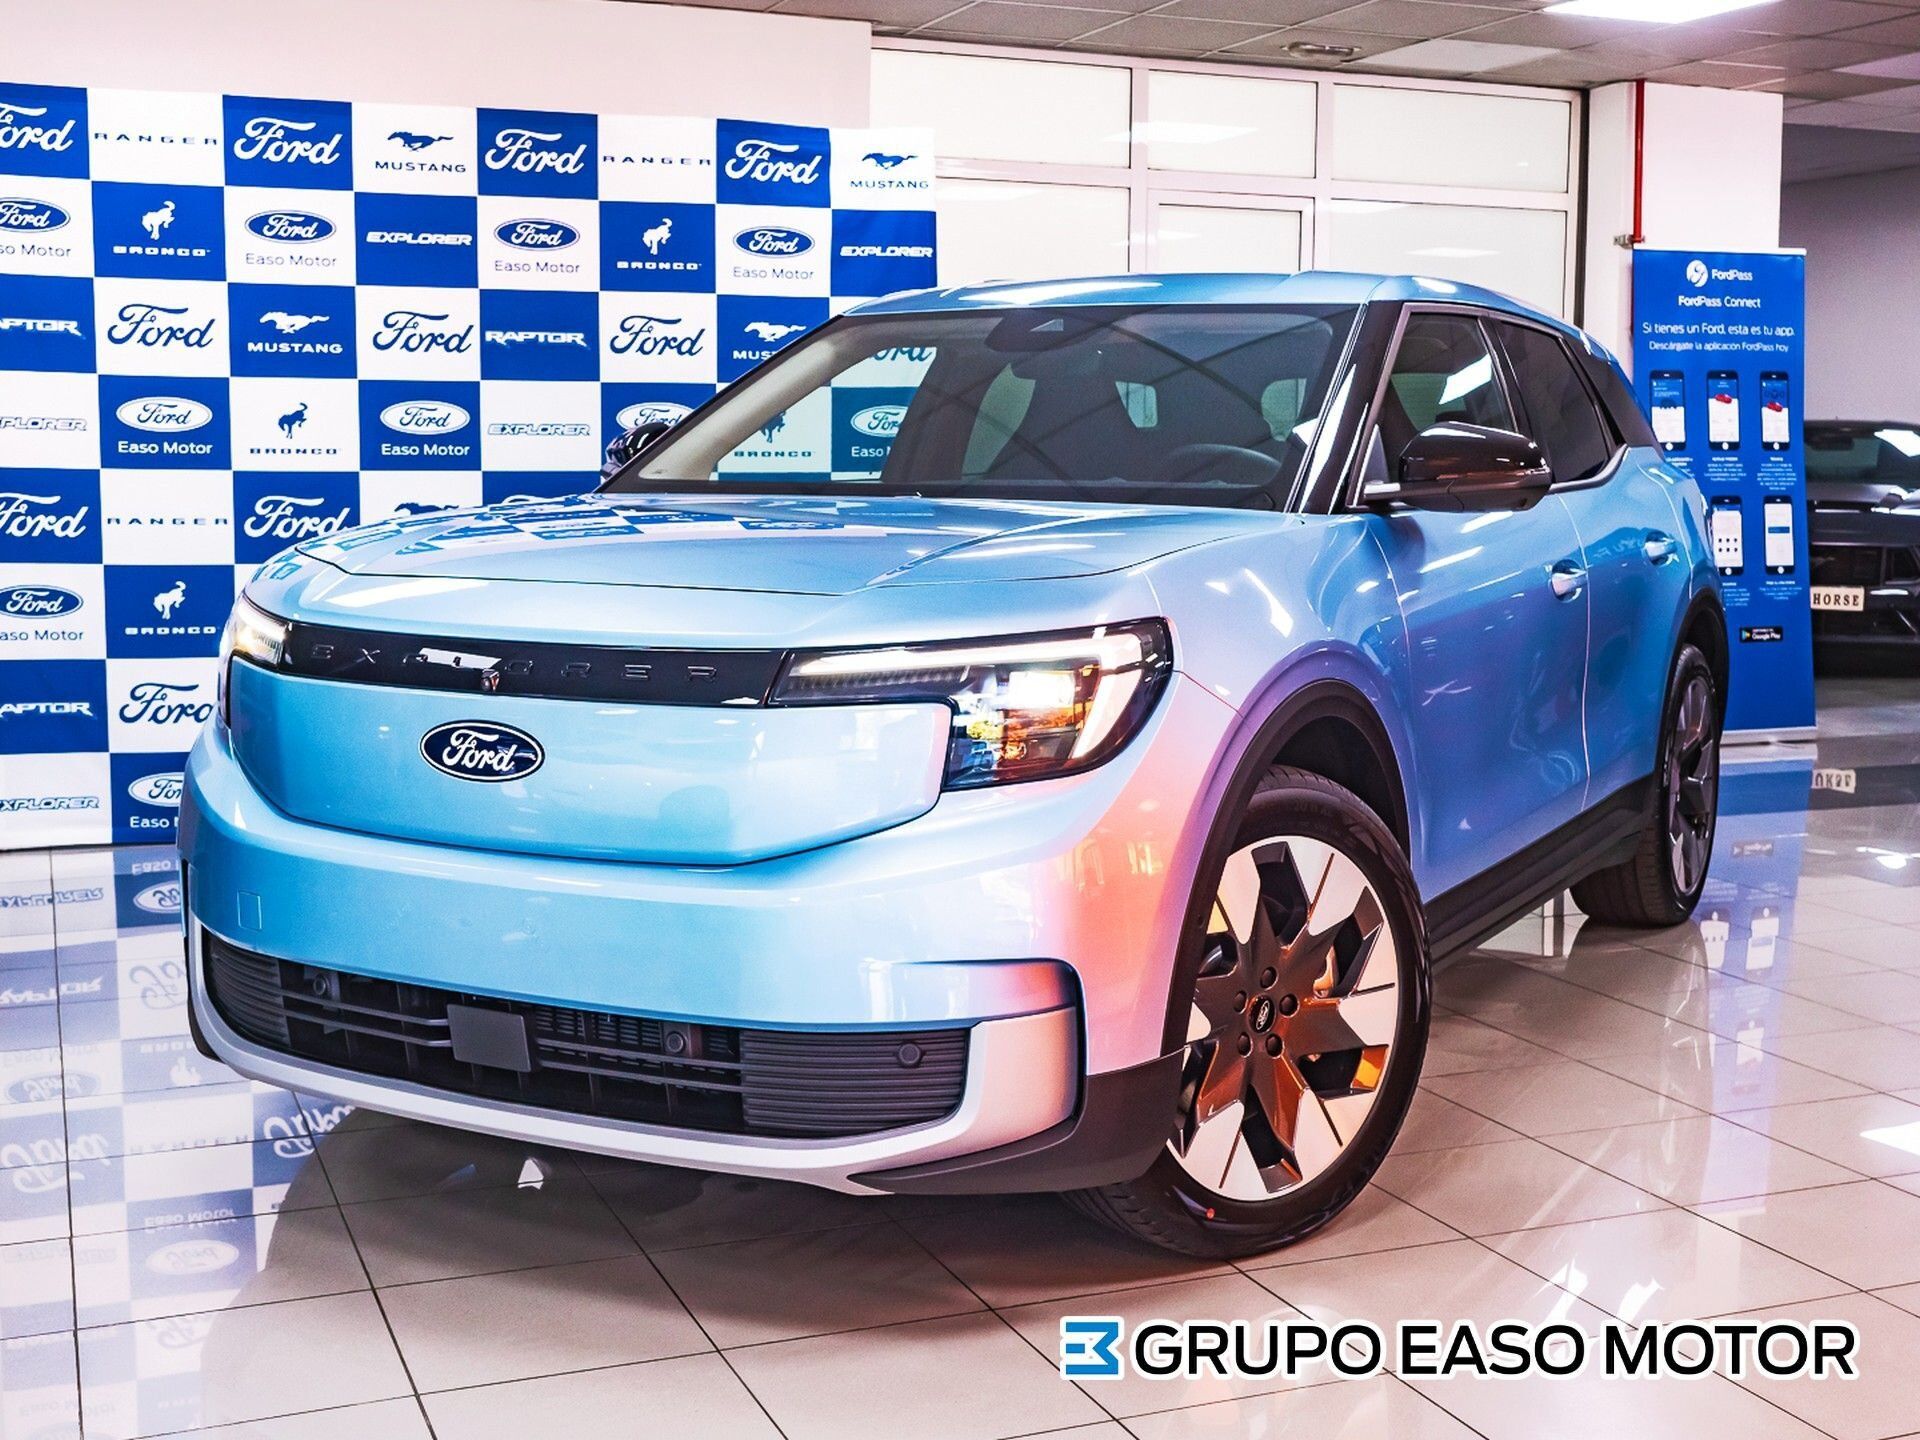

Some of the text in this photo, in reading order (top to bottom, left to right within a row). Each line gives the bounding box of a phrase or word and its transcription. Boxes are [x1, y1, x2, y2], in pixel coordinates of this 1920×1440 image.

[95, 133, 216, 145] RANGER
[234, 118, 342, 164] Ford
[485, 129, 586, 173] Ford
[376, 161, 465, 172] MUSTANG
[604, 156, 710, 165] RANGER
[725, 140, 822, 184] Ford
[262, 215, 318, 239] Ford
[510, 222, 563, 246] Ford
[366, 231, 473, 246] EXPLORER
[748, 229, 797, 253] Ford
[22, 245, 71, 257] Motor
[840, 246, 933, 258] EXPLORER
[245, 253, 337, 268] Easo Motor
[494, 260, 580, 275] Easo Motor
[733, 266, 814, 280] Easo Motor
[1712, 269, 1753, 281] FordPass
[1679, 296, 1761, 308] FordPass Connect
[108, 304, 215, 348] Ford
[373, 311, 473, 353] Ford
[1655, 323, 1684, 334] tienes
[1687, 326, 1699, 334] un
[1728, 325, 1748, 335] esta
[1751, 327, 1761, 335] es
[1764, 326, 1772, 335] tu
[485, 330, 587, 347] RAPTOR
[610, 316, 705, 356] Ford
[248, 343, 342, 353] MUSTANG
[733, 350, 780, 360] MUS
[136, 401, 192, 426] Ford
[400, 405, 451, 430] Ford
[868, 412, 901, 430] For
[0, 416, 87, 431] PLORER
[487, 422, 591, 437] EXPLORER
[118, 441, 213, 455] Easo Motor
[381, 444, 470, 456] Easo Motor
[851, 446, 883, 457] Easo
[243, 495, 349, 538] Ford
[5, 589, 64, 613] Ford
[1813, 594, 1859, 606] HORSE
[0, 630, 83, 641] aso Motor
[0, 702, 93, 717] APTOR
[442, 728, 516, 772] Ford
[148, 777, 182, 799] For
[0, 797, 99, 810] XPLORER
[130, 816, 170, 828] Easo
